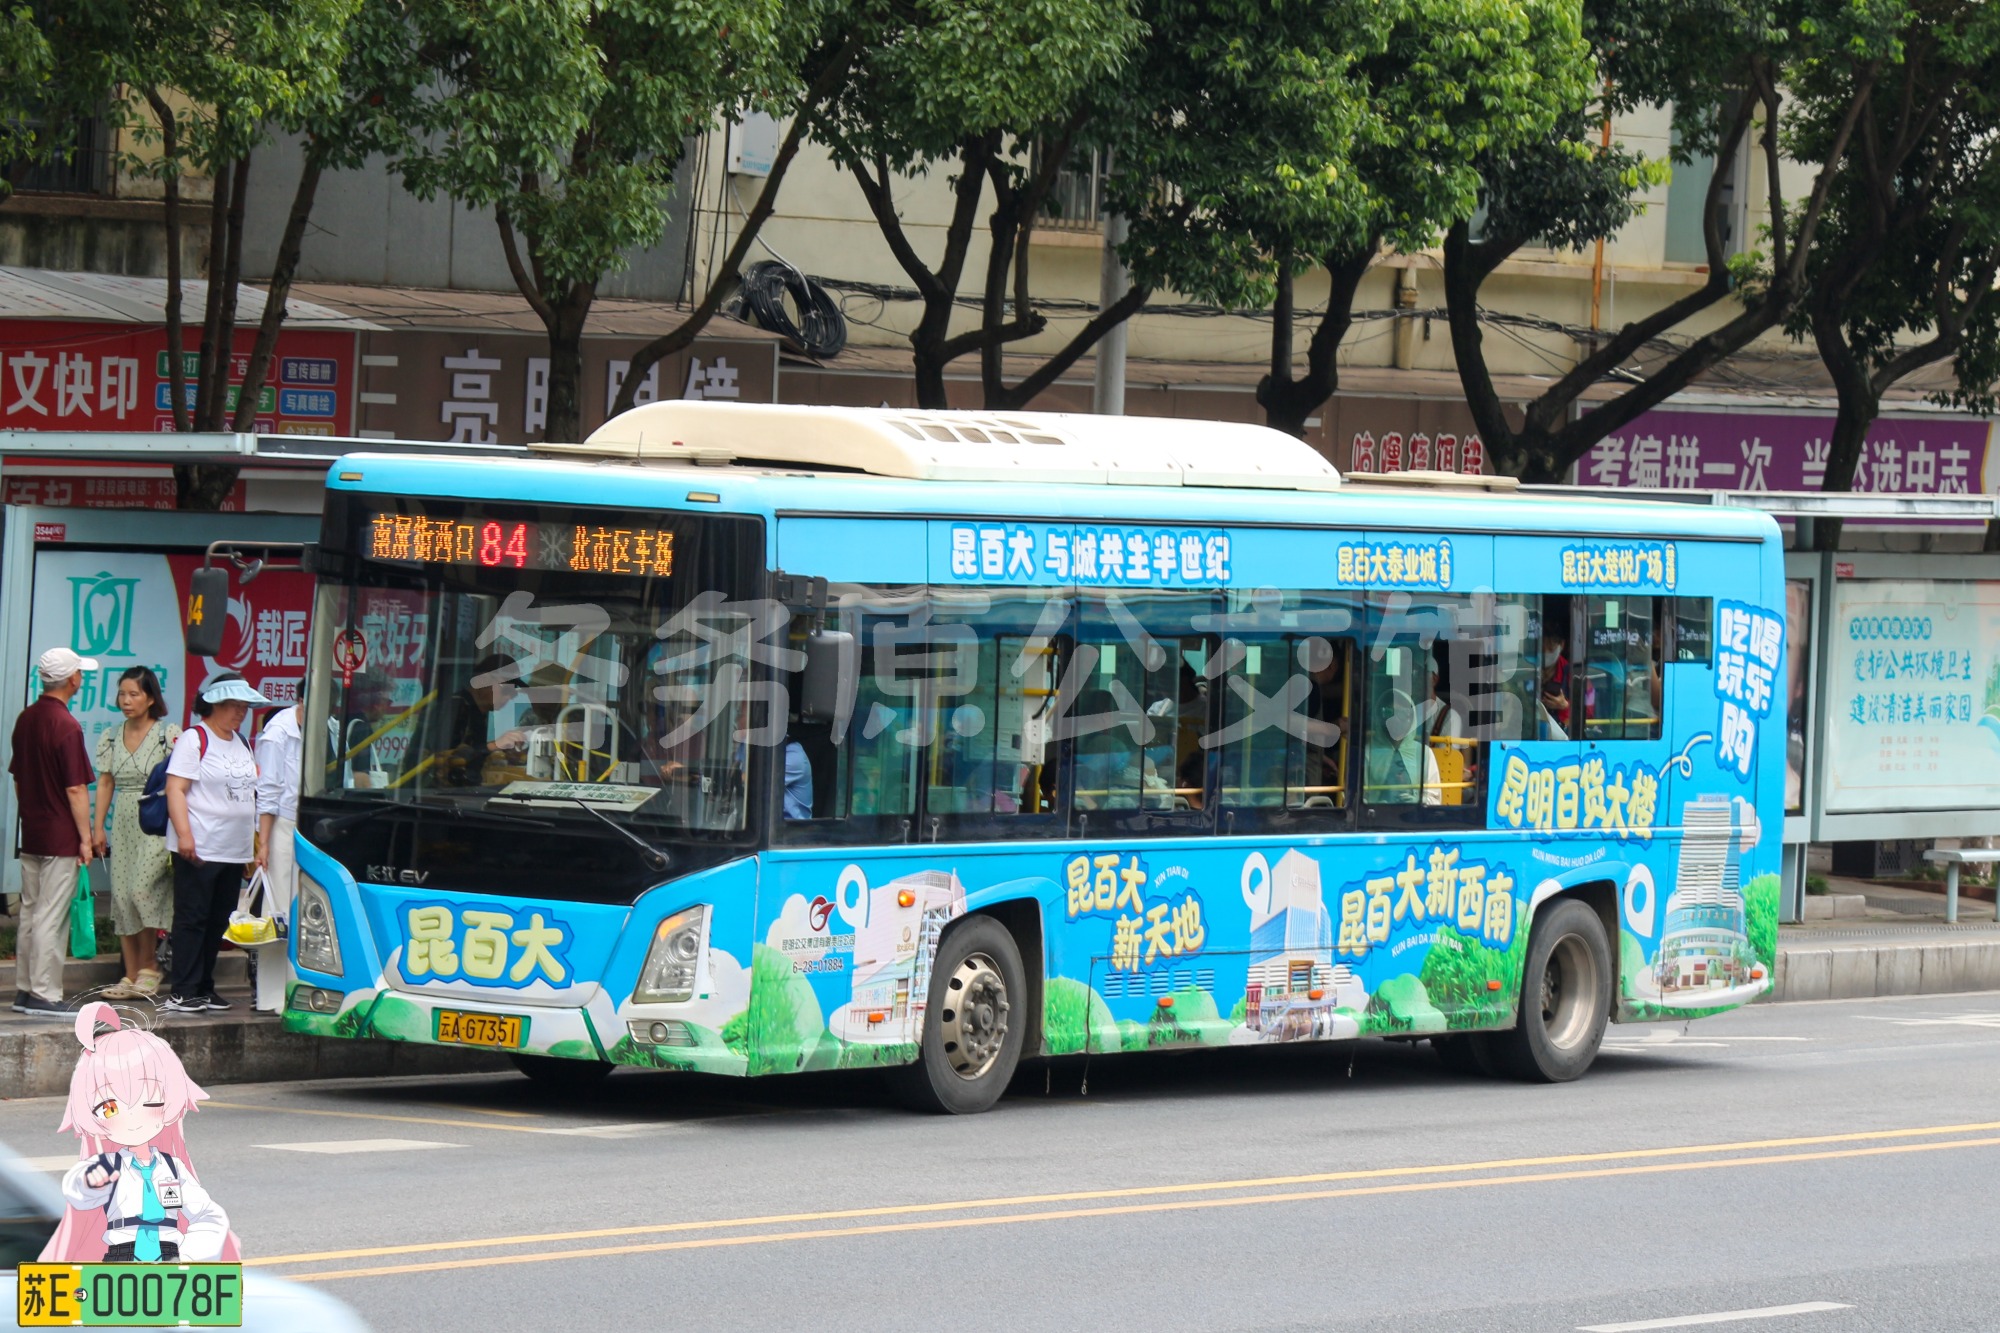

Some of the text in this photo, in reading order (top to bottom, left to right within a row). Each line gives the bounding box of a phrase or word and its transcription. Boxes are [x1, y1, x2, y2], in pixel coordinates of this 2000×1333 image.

[7, 351, 138, 420] 文快印
[287, 362, 331, 380] 宣传画册
[1590, 434, 1773, 491] 考编拼一次
[480, 522, 527, 568] 84
[569, 524, 674, 577] 北市区车场
[952, 528, 1231, 580] 昆百大 与城共生半世纪
[1337, 546, 1437, 583] 昆百大泰业城
[1562, 549, 1662, 588] 昆百大楚悦广场
[264, 682, 295, 701] 周年庆
[1854, 650, 1972, 681] 爱护公共环境卫生
[1850, 693, 1972, 725] 建设清洁美丽家园
[1720, 701, 1755, 775] 购
[1497, 754, 1659, 840] 昆明百货大楼
[1066, 853, 1144, 914] 昆百大
[1340, 845, 1515, 957] 昆百大新西南
[407, 905, 565, 983] 昆百大
[1112, 894, 1204, 973] 新天地
